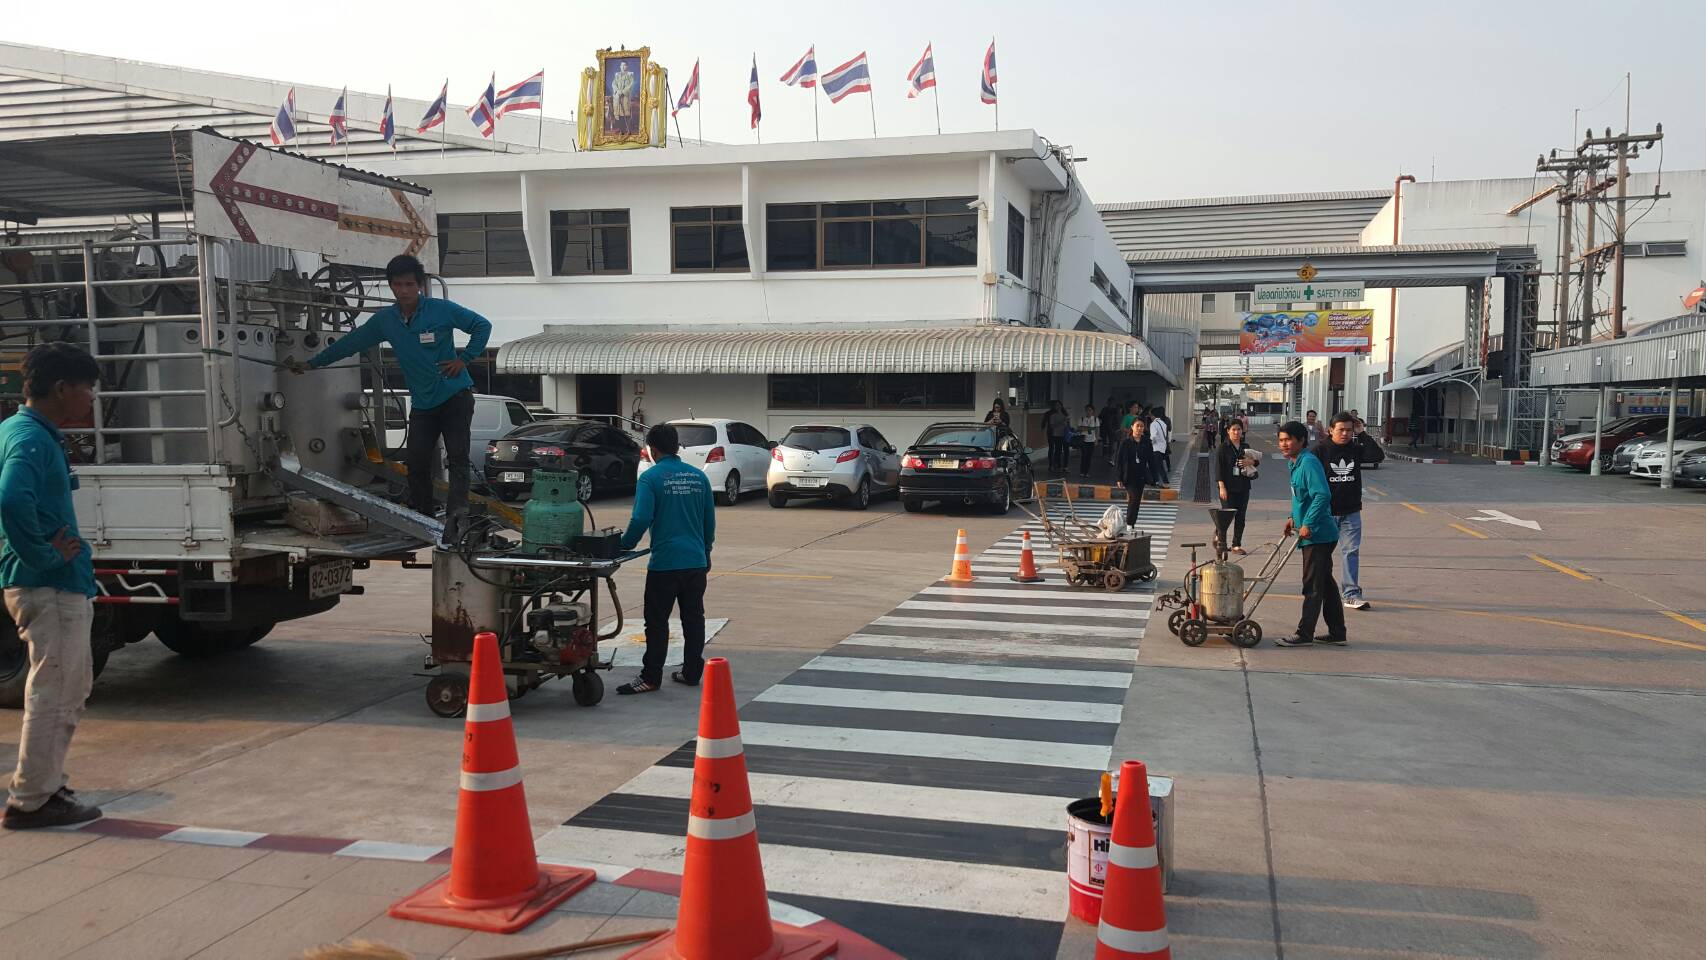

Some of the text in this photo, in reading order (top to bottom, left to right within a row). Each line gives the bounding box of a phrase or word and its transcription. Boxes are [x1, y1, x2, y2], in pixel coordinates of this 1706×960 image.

[1257, 286, 1301, 300] ปลอดภัยไว้ก่อน
[1316, 288, 1361, 298] SAFETY FIRST
[311, 565, 351, 589] 82-0372
